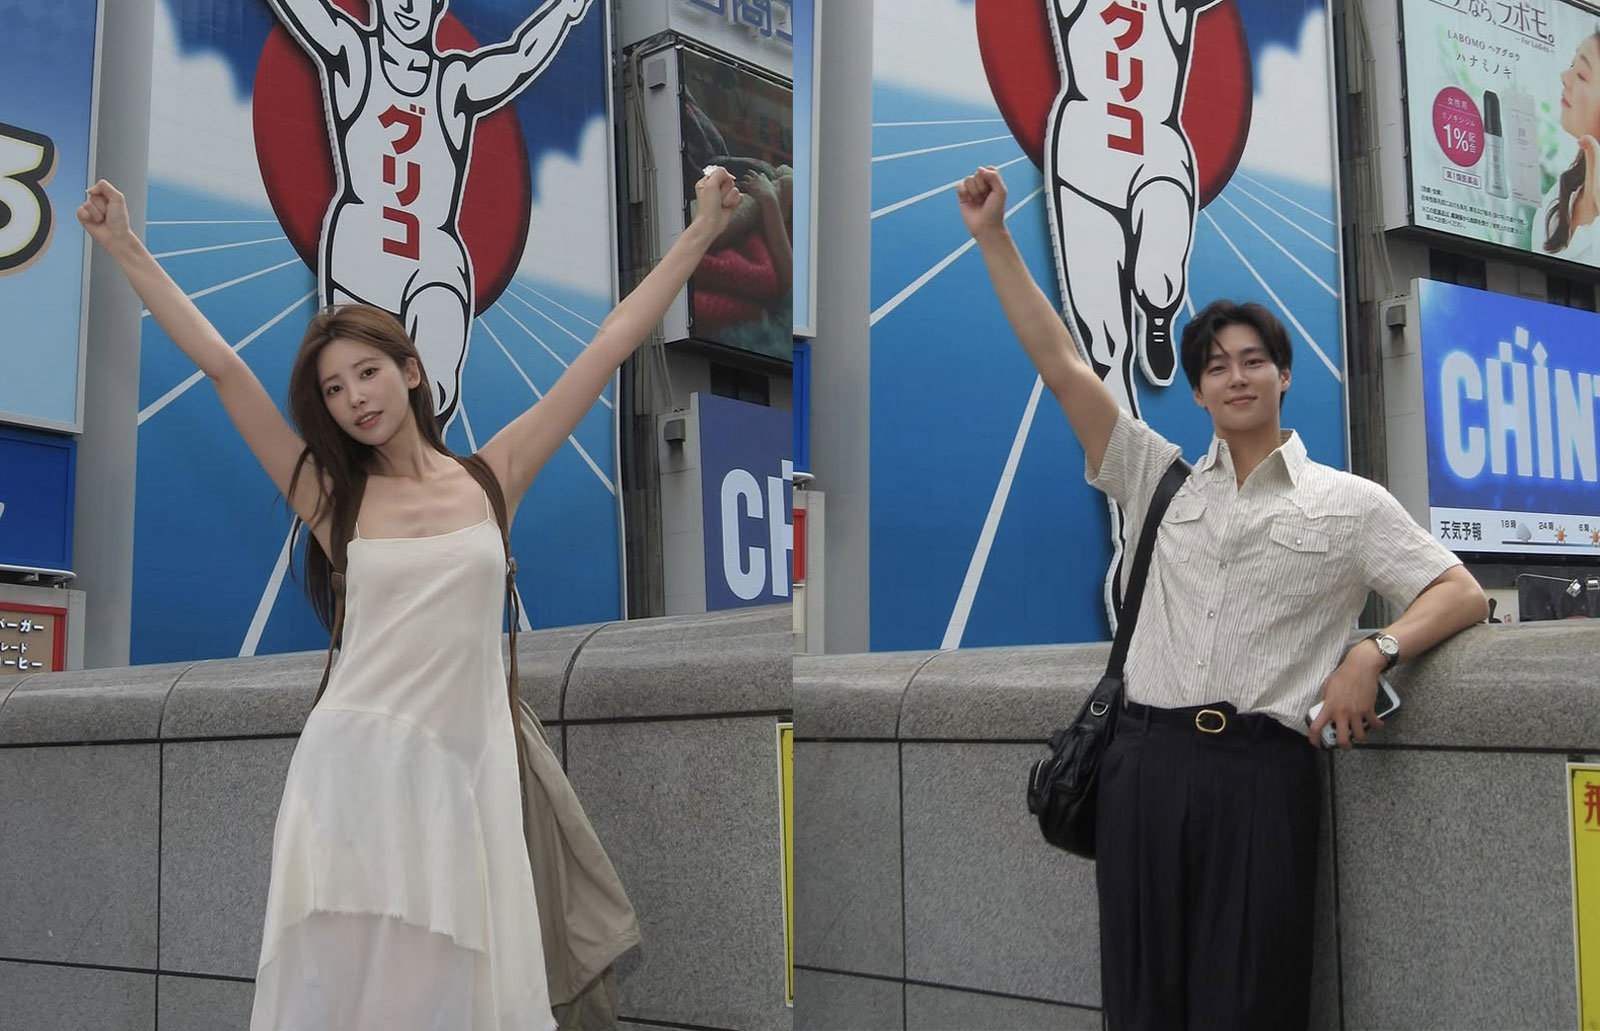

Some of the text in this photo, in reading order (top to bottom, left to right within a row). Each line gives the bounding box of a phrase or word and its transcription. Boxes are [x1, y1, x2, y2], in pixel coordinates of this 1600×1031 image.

[1447, 30, 1486, 50] LABOMO
[1099, 0, 1147, 156] グリコ
[1456, 53, 1512, 80] ハナミノキ
[1443, 123, 1469, 152] 1%
[377, 104, 426, 261] グリコ
[1440, 520, 1482, 541] 天気予報
[0, 656, 44, 670] ーヒー
